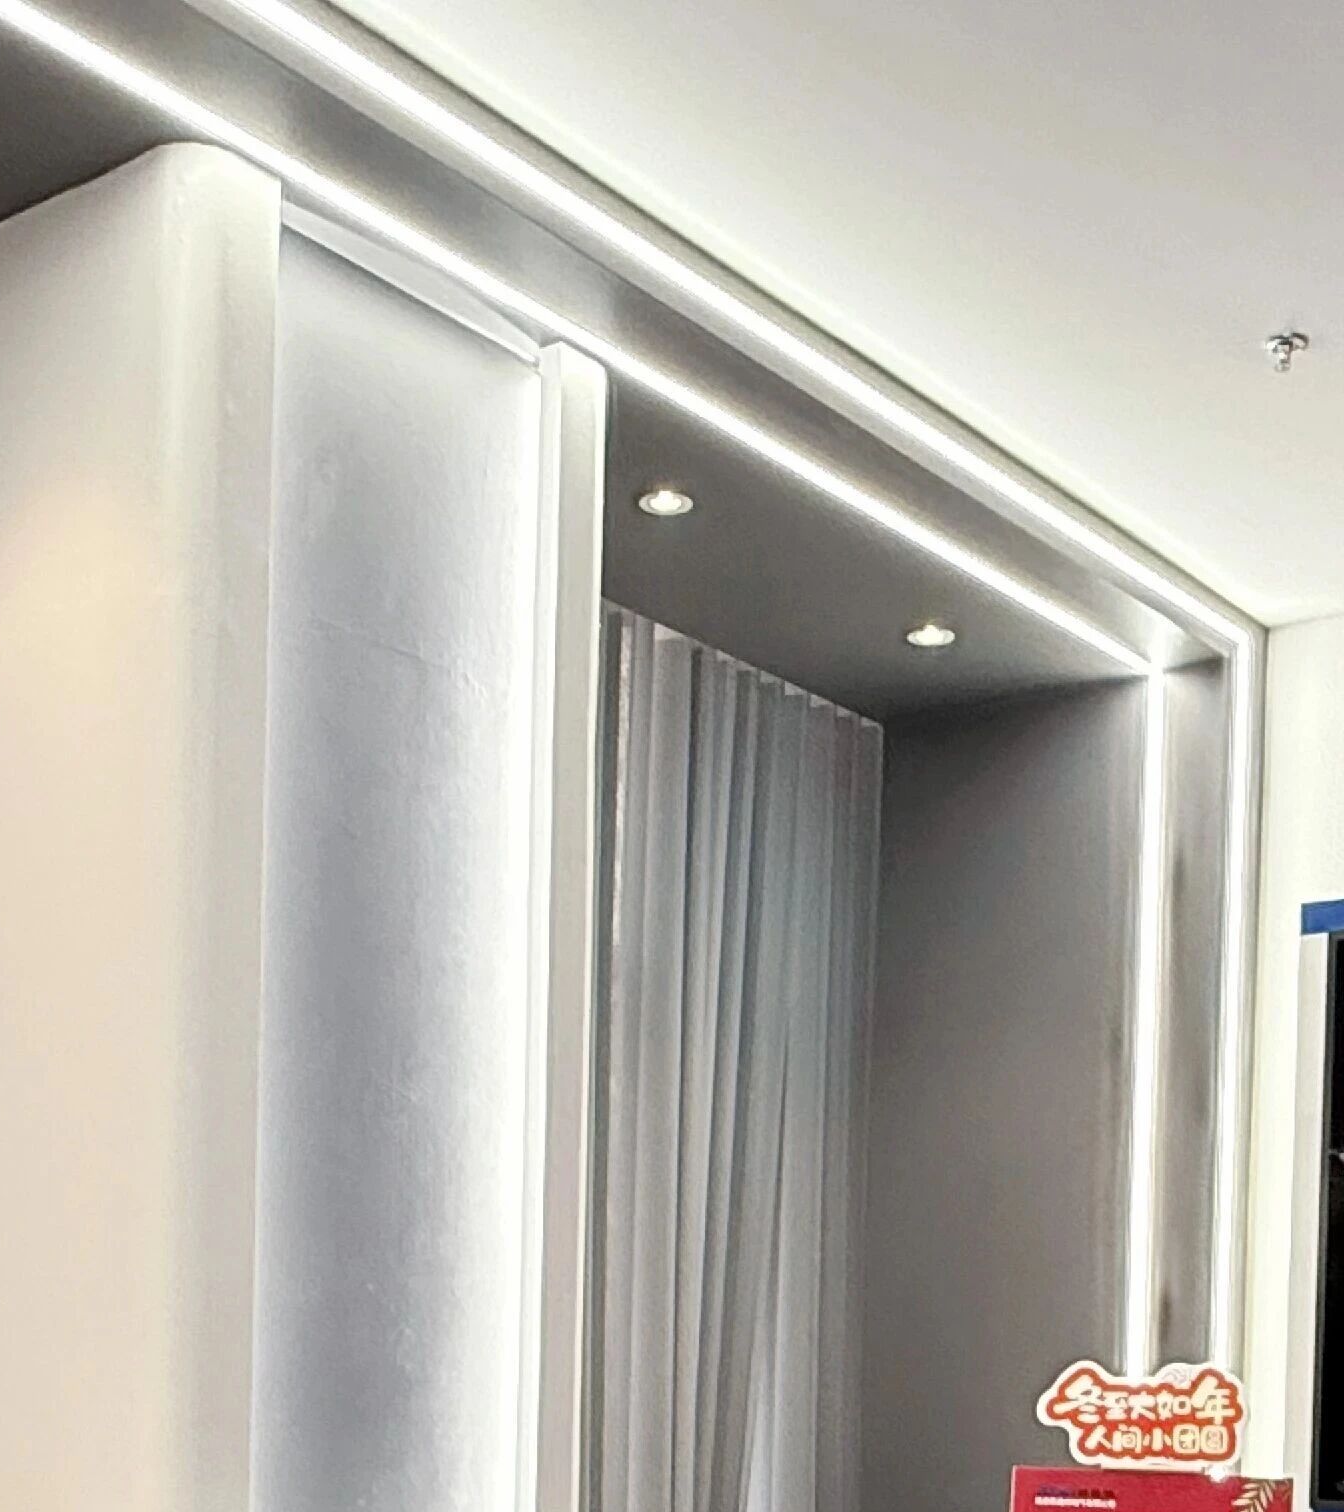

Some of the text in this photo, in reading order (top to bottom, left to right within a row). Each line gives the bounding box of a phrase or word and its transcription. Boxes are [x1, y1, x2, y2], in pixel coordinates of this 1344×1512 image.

[1053, 1374, 1236, 1426] 冬至大如年
[1084, 1423, 1229, 1455] 人间小团圆
